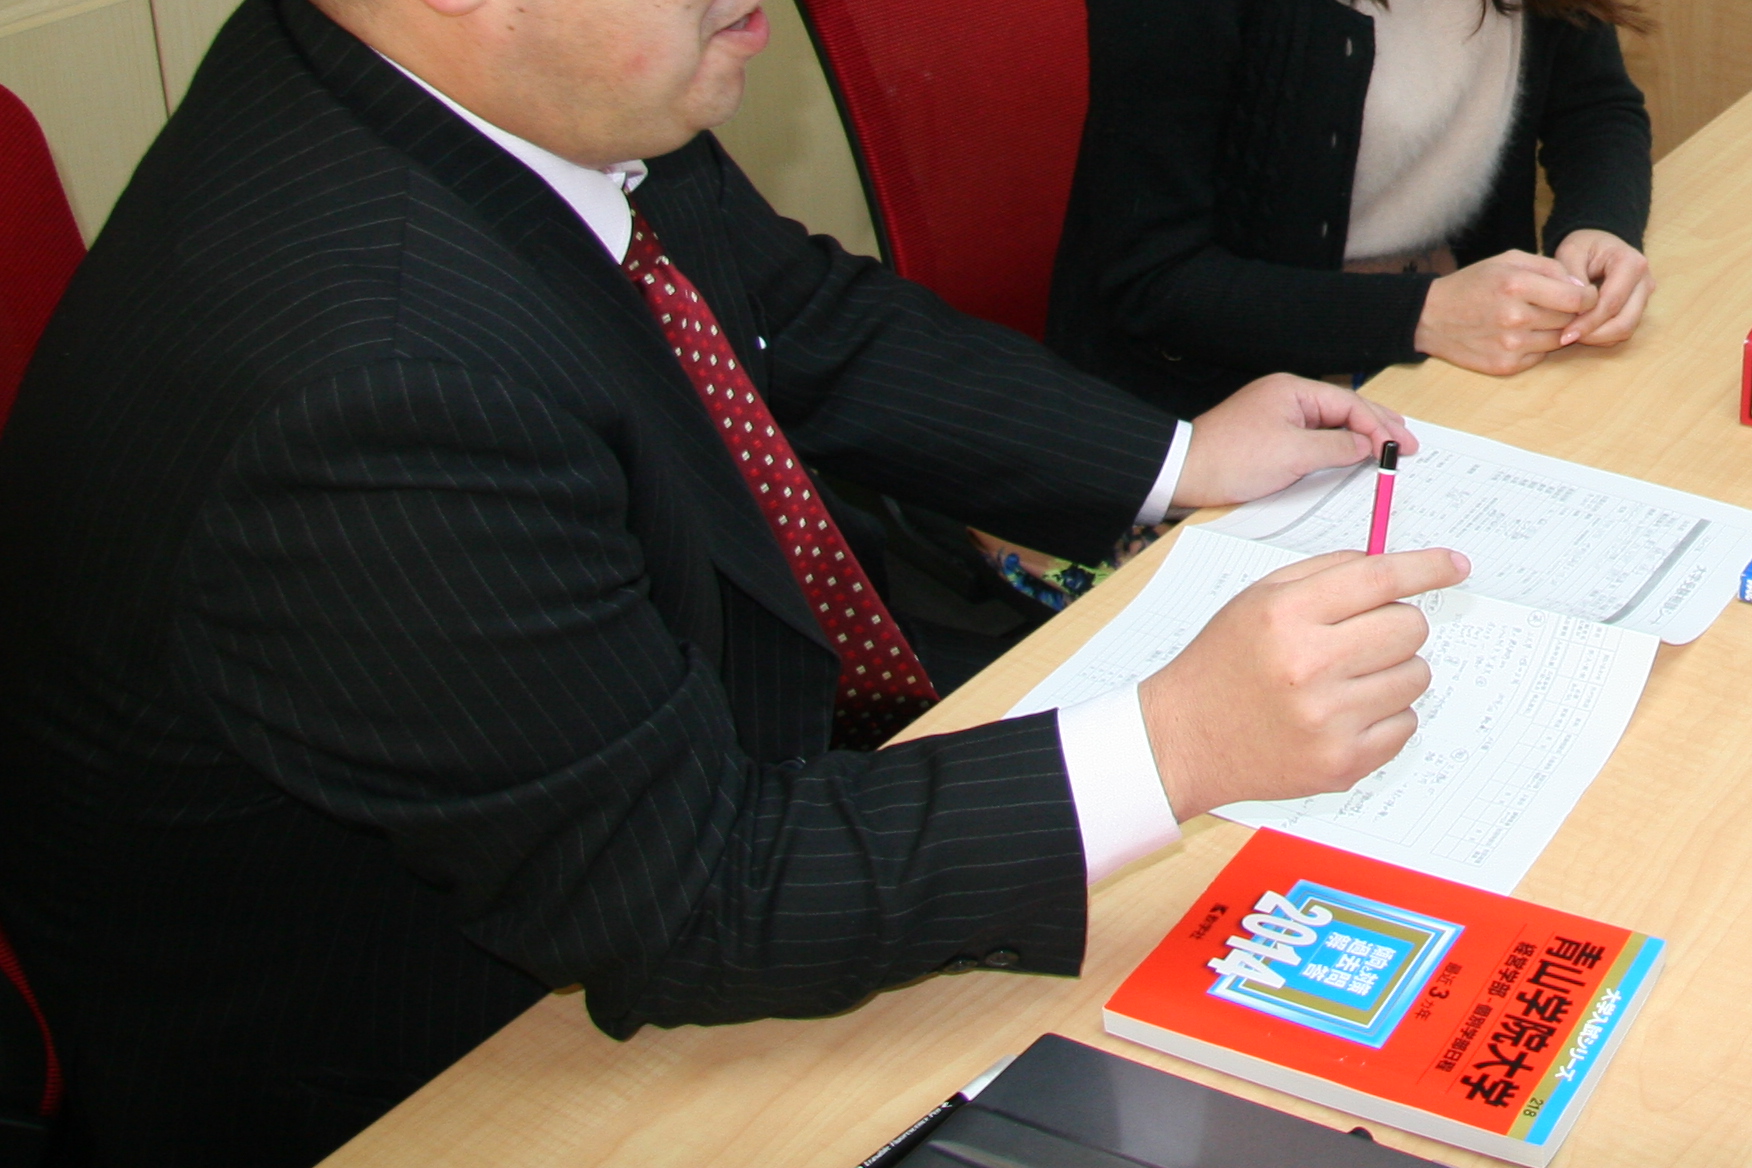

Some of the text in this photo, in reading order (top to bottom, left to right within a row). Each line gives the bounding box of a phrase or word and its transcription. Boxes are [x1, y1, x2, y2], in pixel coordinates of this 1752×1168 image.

[1189, 913, 1219, 942] 教学社
[1208, 891, 1334, 988] 2014
[1301, 931, 1352, 982] 解答
[1325, 936, 1374, 988] 過去問
[1349, 943, 1398, 996] 傾向と対策
[1460, 935, 1606, 1108] 青山学院大学
[1554, 987, 1622, 1081] 大学入試シリーズ
[1522, 1097, 1544, 1118] 218
